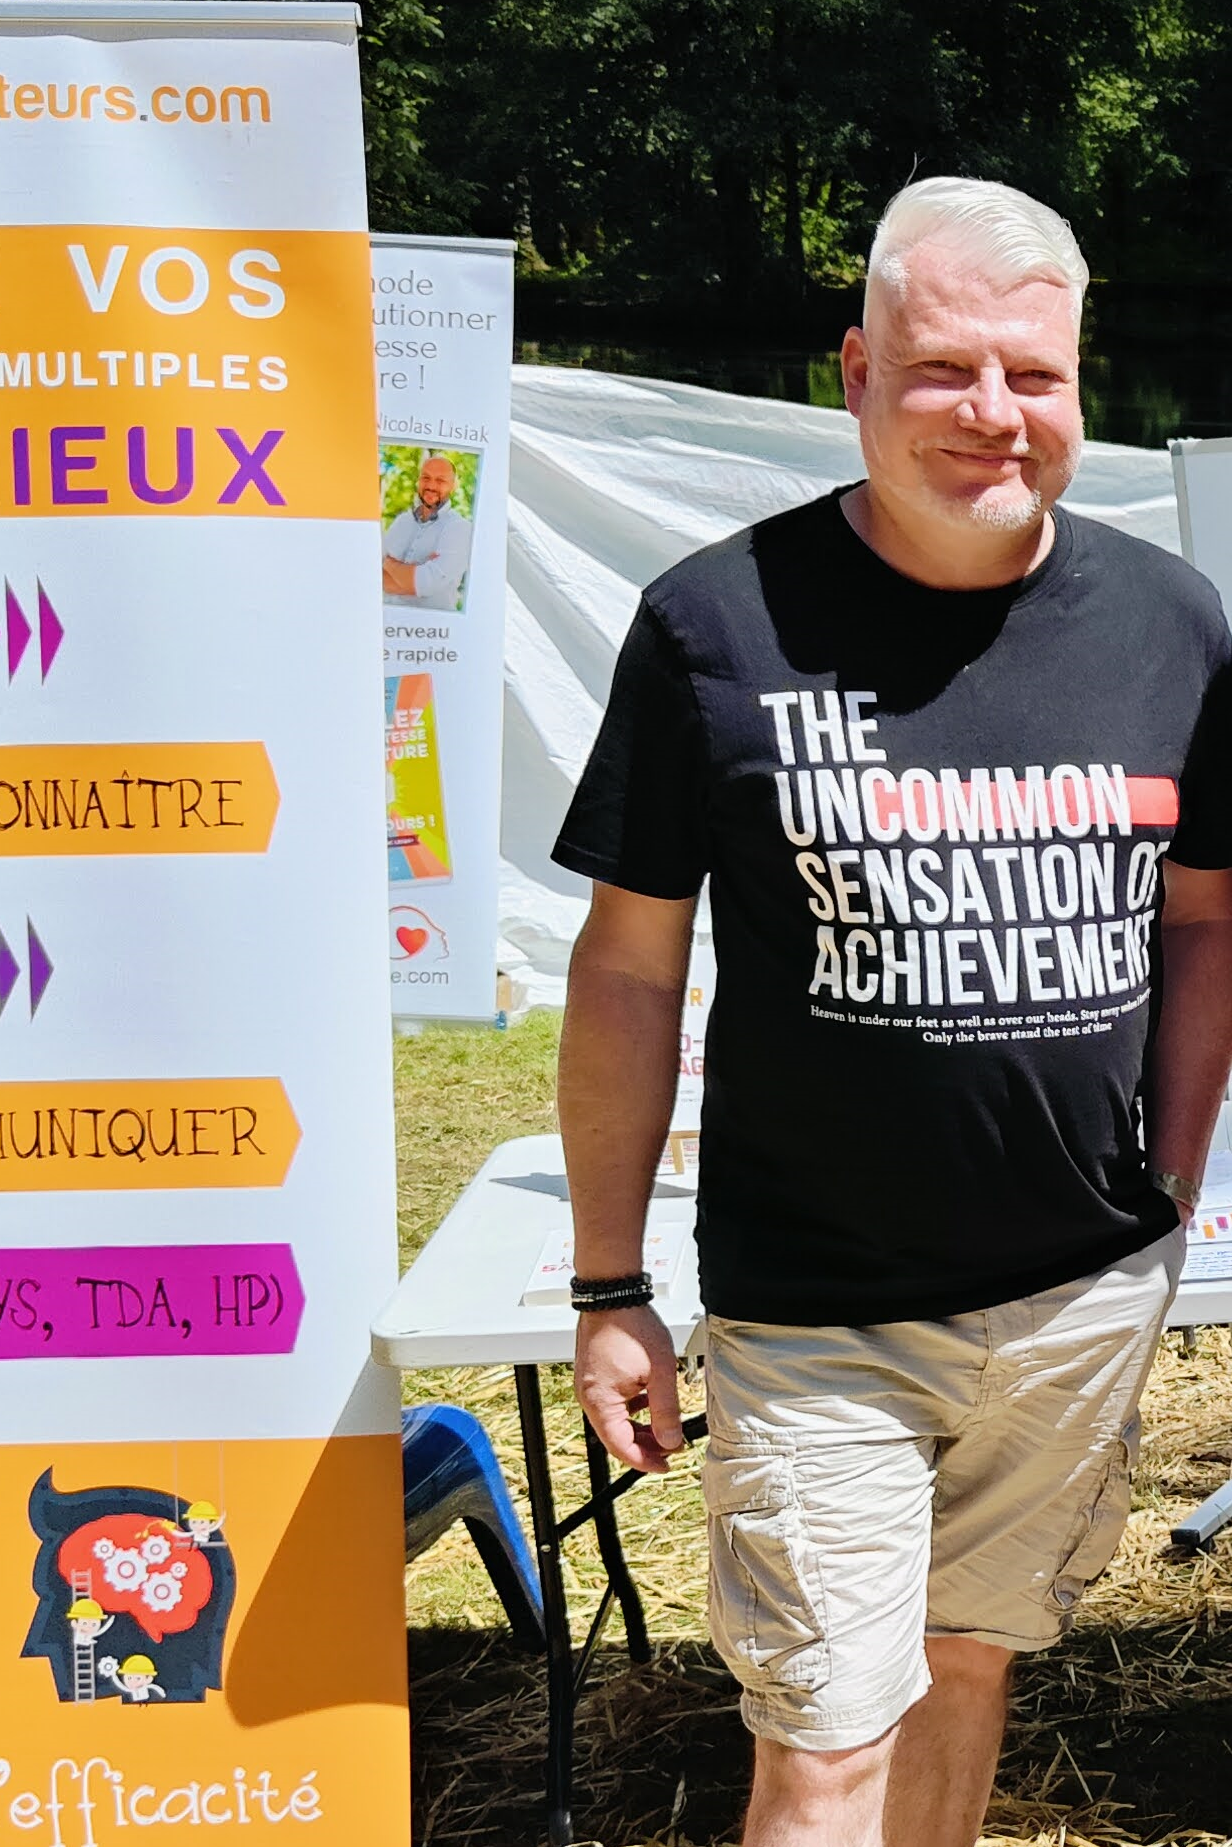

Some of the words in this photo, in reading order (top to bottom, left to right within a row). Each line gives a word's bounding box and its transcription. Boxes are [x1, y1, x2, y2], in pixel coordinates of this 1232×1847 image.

[67, 244, 287, 319] VOS
[372, 303, 497, 331] utionner
[375, 340, 438, 359] esse
[0, 350, 289, 391] MULTIPLES
[438, 419, 489, 444] Lisiak
[12, 425, 288, 507] IEUX
[384, 625, 450, 639] erveau
[396, 646, 459, 665] rapide
[760, 690, 887, 766] THE
[774, 763, 1132, 846] UNCOMMON
[796, 842, 1115, 925] SENSATION
[808, 912, 1155, 1006] ACHIEVEMENT
[390, 970, 449, 984] e.com
[811, 1004, 845, 1022] Heaven
[848, 1012, 857, 1023] is
[859, 1015, 890, 1026] under
[893, 1017, 913, 1028] our
[916, 1015, 939, 1028] feet
[942, 1018, 954, 1028] as
[957, 1015, 982, 1028] well
[984, 1016, 996, 1026] as
[998, 1016, 1023, 1026] over
[1025, 1014, 1045, 1025] our
[1047, 1011, 1079, 1023] heads.
[1080, 1009, 1100, 1022] Stay
[923, 1031, 953, 1046] Only
[956, 1031, 975, 1043] the
[977, 1030, 1009, 1042] brave
[1010, 1027, 1041, 1040] stand
[1043, 1027, 1061, 1038] the
[1062, 1025, 1081, 1036] test
[1082, 1022, 1092, 1034] of
[76, 1276, 192, 1339] TDA,
[214, 1273, 284, 1326] HP)
